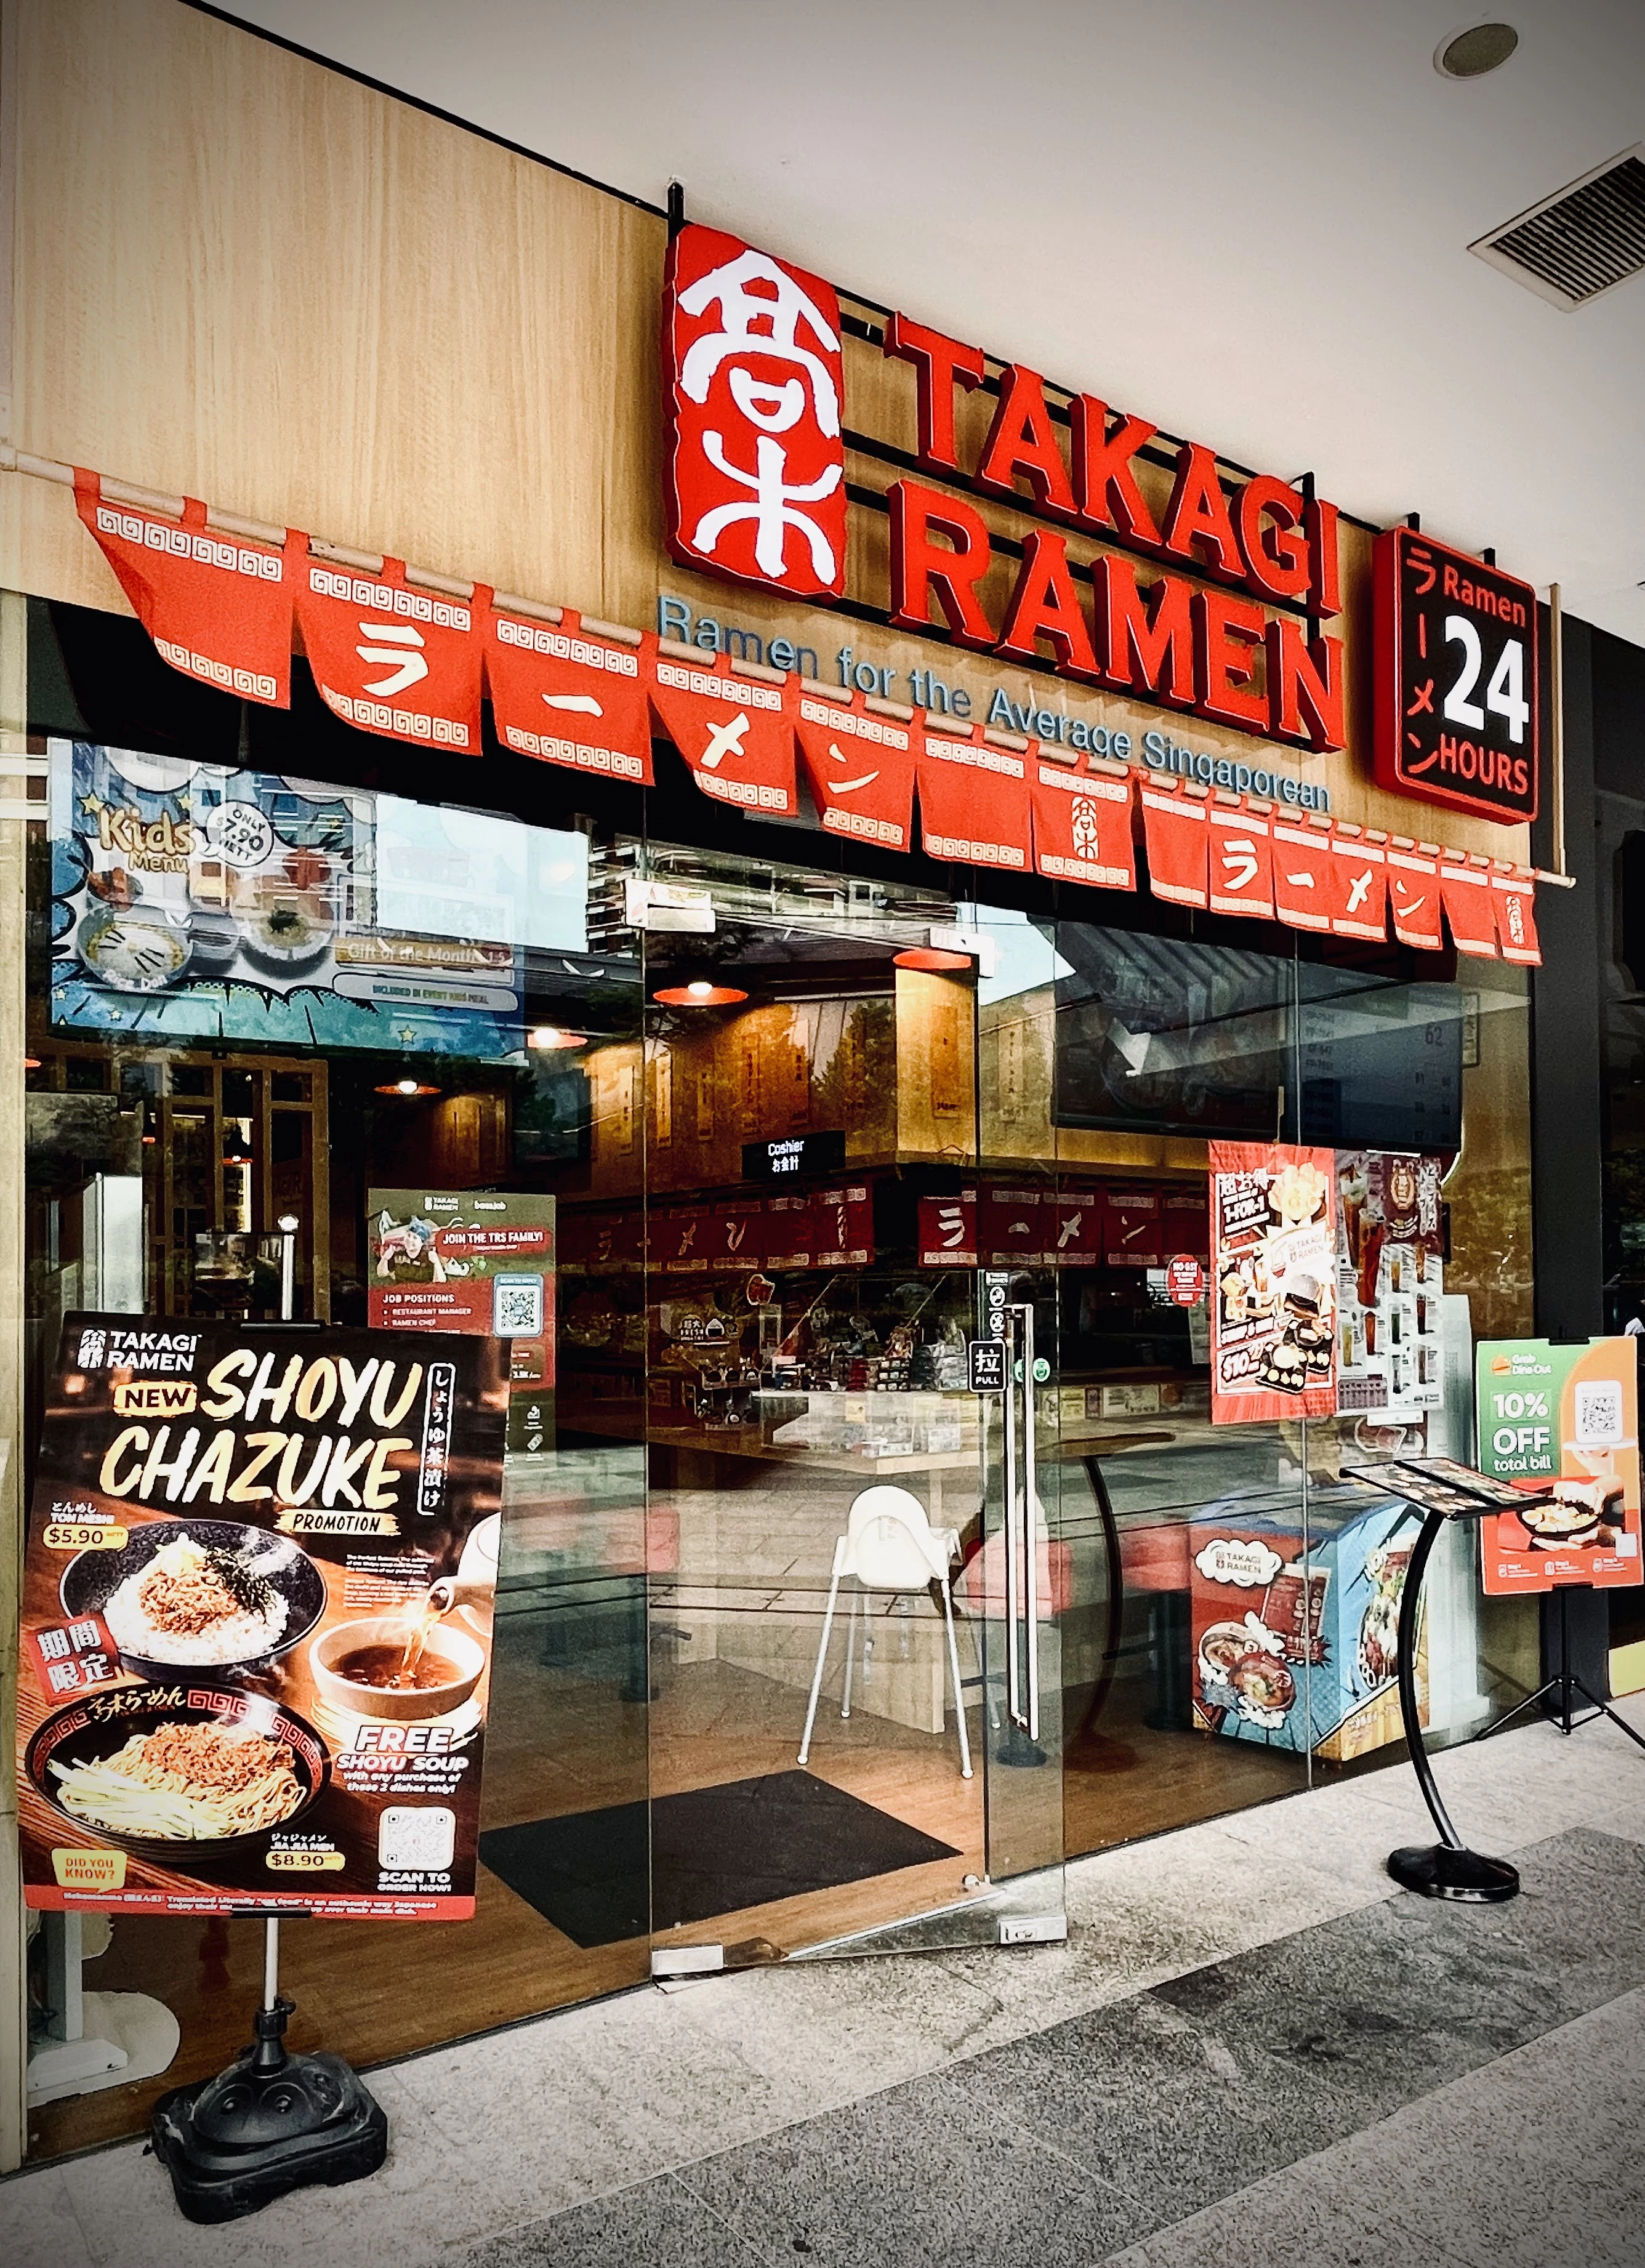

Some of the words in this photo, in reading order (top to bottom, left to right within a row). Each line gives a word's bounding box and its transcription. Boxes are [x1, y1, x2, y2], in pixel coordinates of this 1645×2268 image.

[887, 312, 1341, 619] TAKAGI
[1443, 563, 1526, 627] Ramen
[888, 480, 1347, 752] RAMEN
[1406, 547, 1439, 774] ラーメン
[1444, 615, 1529, 744] 24
[659, 595, 818, 678] Ramen
[838, 646, 895, 699] for
[911, 669, 971, 717] the
[989, 686, 1133, 759] Average
[1143, 730, 1331, 813] Singaporean
[1440, 733, 1528, 796] HOURS
[99, 805, 196, 856] Kids
[233, 808, 266, 832] ONLY
[128, 851, 190, 874] Menu
[347, 944, 377, 959] Gift
[768, 1139, 805, 1157] Cashier
[443, 1233, 466, 1245] JOIN
[467, 1233, 487, 1244] THE
[488, 1232, 507, 1243] TRS
[508, 1231, 544, 1242] FAMILY!
[383, 1293, 402, 1303] JOB
[404, 1294, 455, 1303] POSITIONS
[111, 1331, 198, 1353] TAKAGI
[107, 1350, 195, 1372] RAMEN
[975, 1348, 1000, 1373] 拉
[1512, 1354, 1537, 1364] Grab
[1512, 1364, 1533, 1375] Dine
[1533, 1364, 1552, 1375] Out
[200, 1349, 424, 1430] SHOYU
[975, 1375, 999, 1385] PULL
[124, 1387, 191, 1409] NEW
[1492, 1392, 1549, 1419] 10%
[1492, 1426, 1551, 1455] OFF
[100, 1425, 414, 1510] CHAZUKE
[1494, 1456, 1528, 1472] total
[1529, 1455, 1552, 1470] bill
[293, 1513, 382, 1533] PROMOTION
[49, 1527, 103, 1544] $5.90
[1227, 1563, 1261, 1574] RAMEN
[36, 1619, 102, 1661] 期間
[47, 1654, 115, 1694] 限定
[356, 1726, 453, 1753] FREE
[336, 1754, 408, 1771] SHOYU
[411, 1756, 470, 1772] SOUP
[343, 1771, 369, 1780] with
[371, 1773, 394, 1782] any
[393, 1772, 447, 1782] purchase
[448, 1773, 462, 1782] of
[379, 1783, 388, 1792] 2
[65, 1857, 87, 1867] DID
[89, 1859, 115, 1868] YOU
[271, 1853, 324, 1867] $8.90
[65, 1868, 116, 1881] KNOW?
[378, 1872, 425, 1883] SCAN
[427, 1872, 451, 1884] TO
[377, 1883, 417, 1892] ORDER
